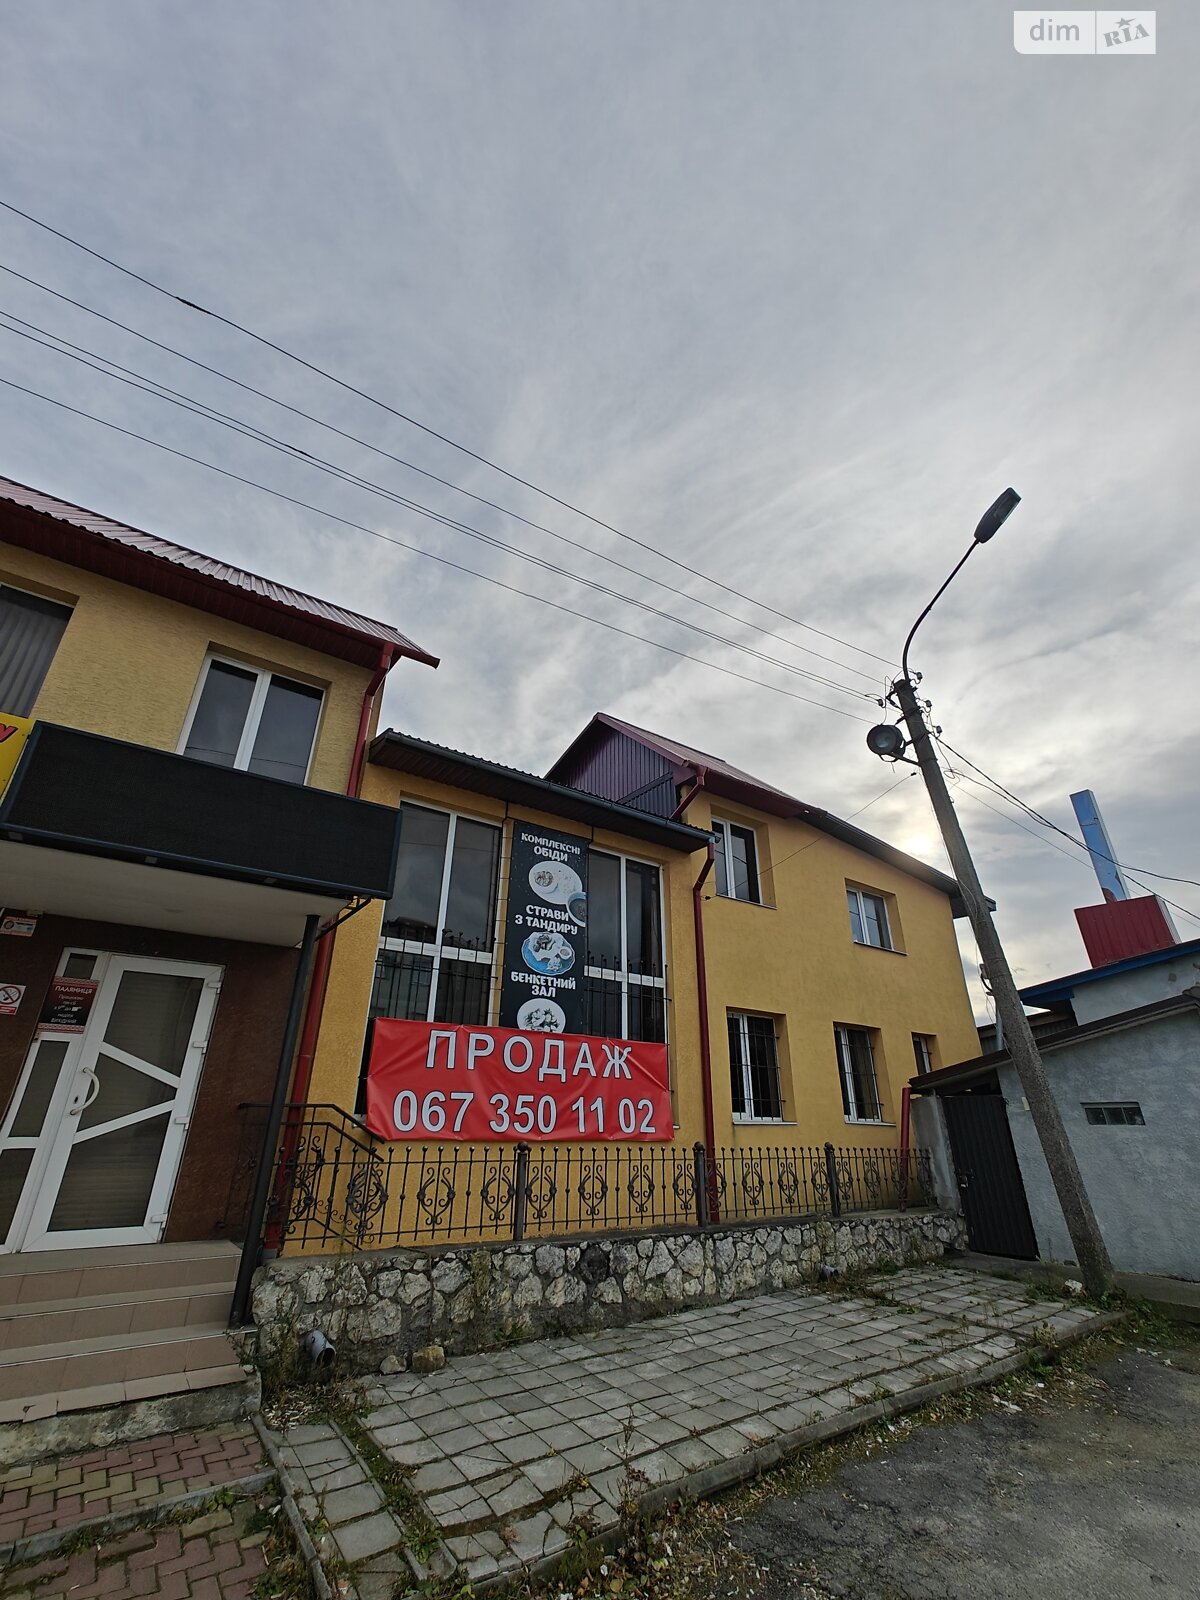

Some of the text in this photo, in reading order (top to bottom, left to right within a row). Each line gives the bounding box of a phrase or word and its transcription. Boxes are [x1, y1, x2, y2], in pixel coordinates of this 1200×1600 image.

[521, 832, 581, 855] КОМПЛЕКСНІ
[533, 845, 568, 862] ОБІДИ
[526, 904, 569, 922] СТРАВИ
[526, 916, 578, 935] ТАНДИРУ
[54, 985, 93, 995] ПАЛЯНИЦЯ
[510, 971, 576, 990] БЕНКЕТНИЙ
[531, 984, 556, 998] ЗАЛ
[425, 1029, 632, 1083] ПРОДАЖ
[393, 1089, 656, 1134] 067 350 11 02
